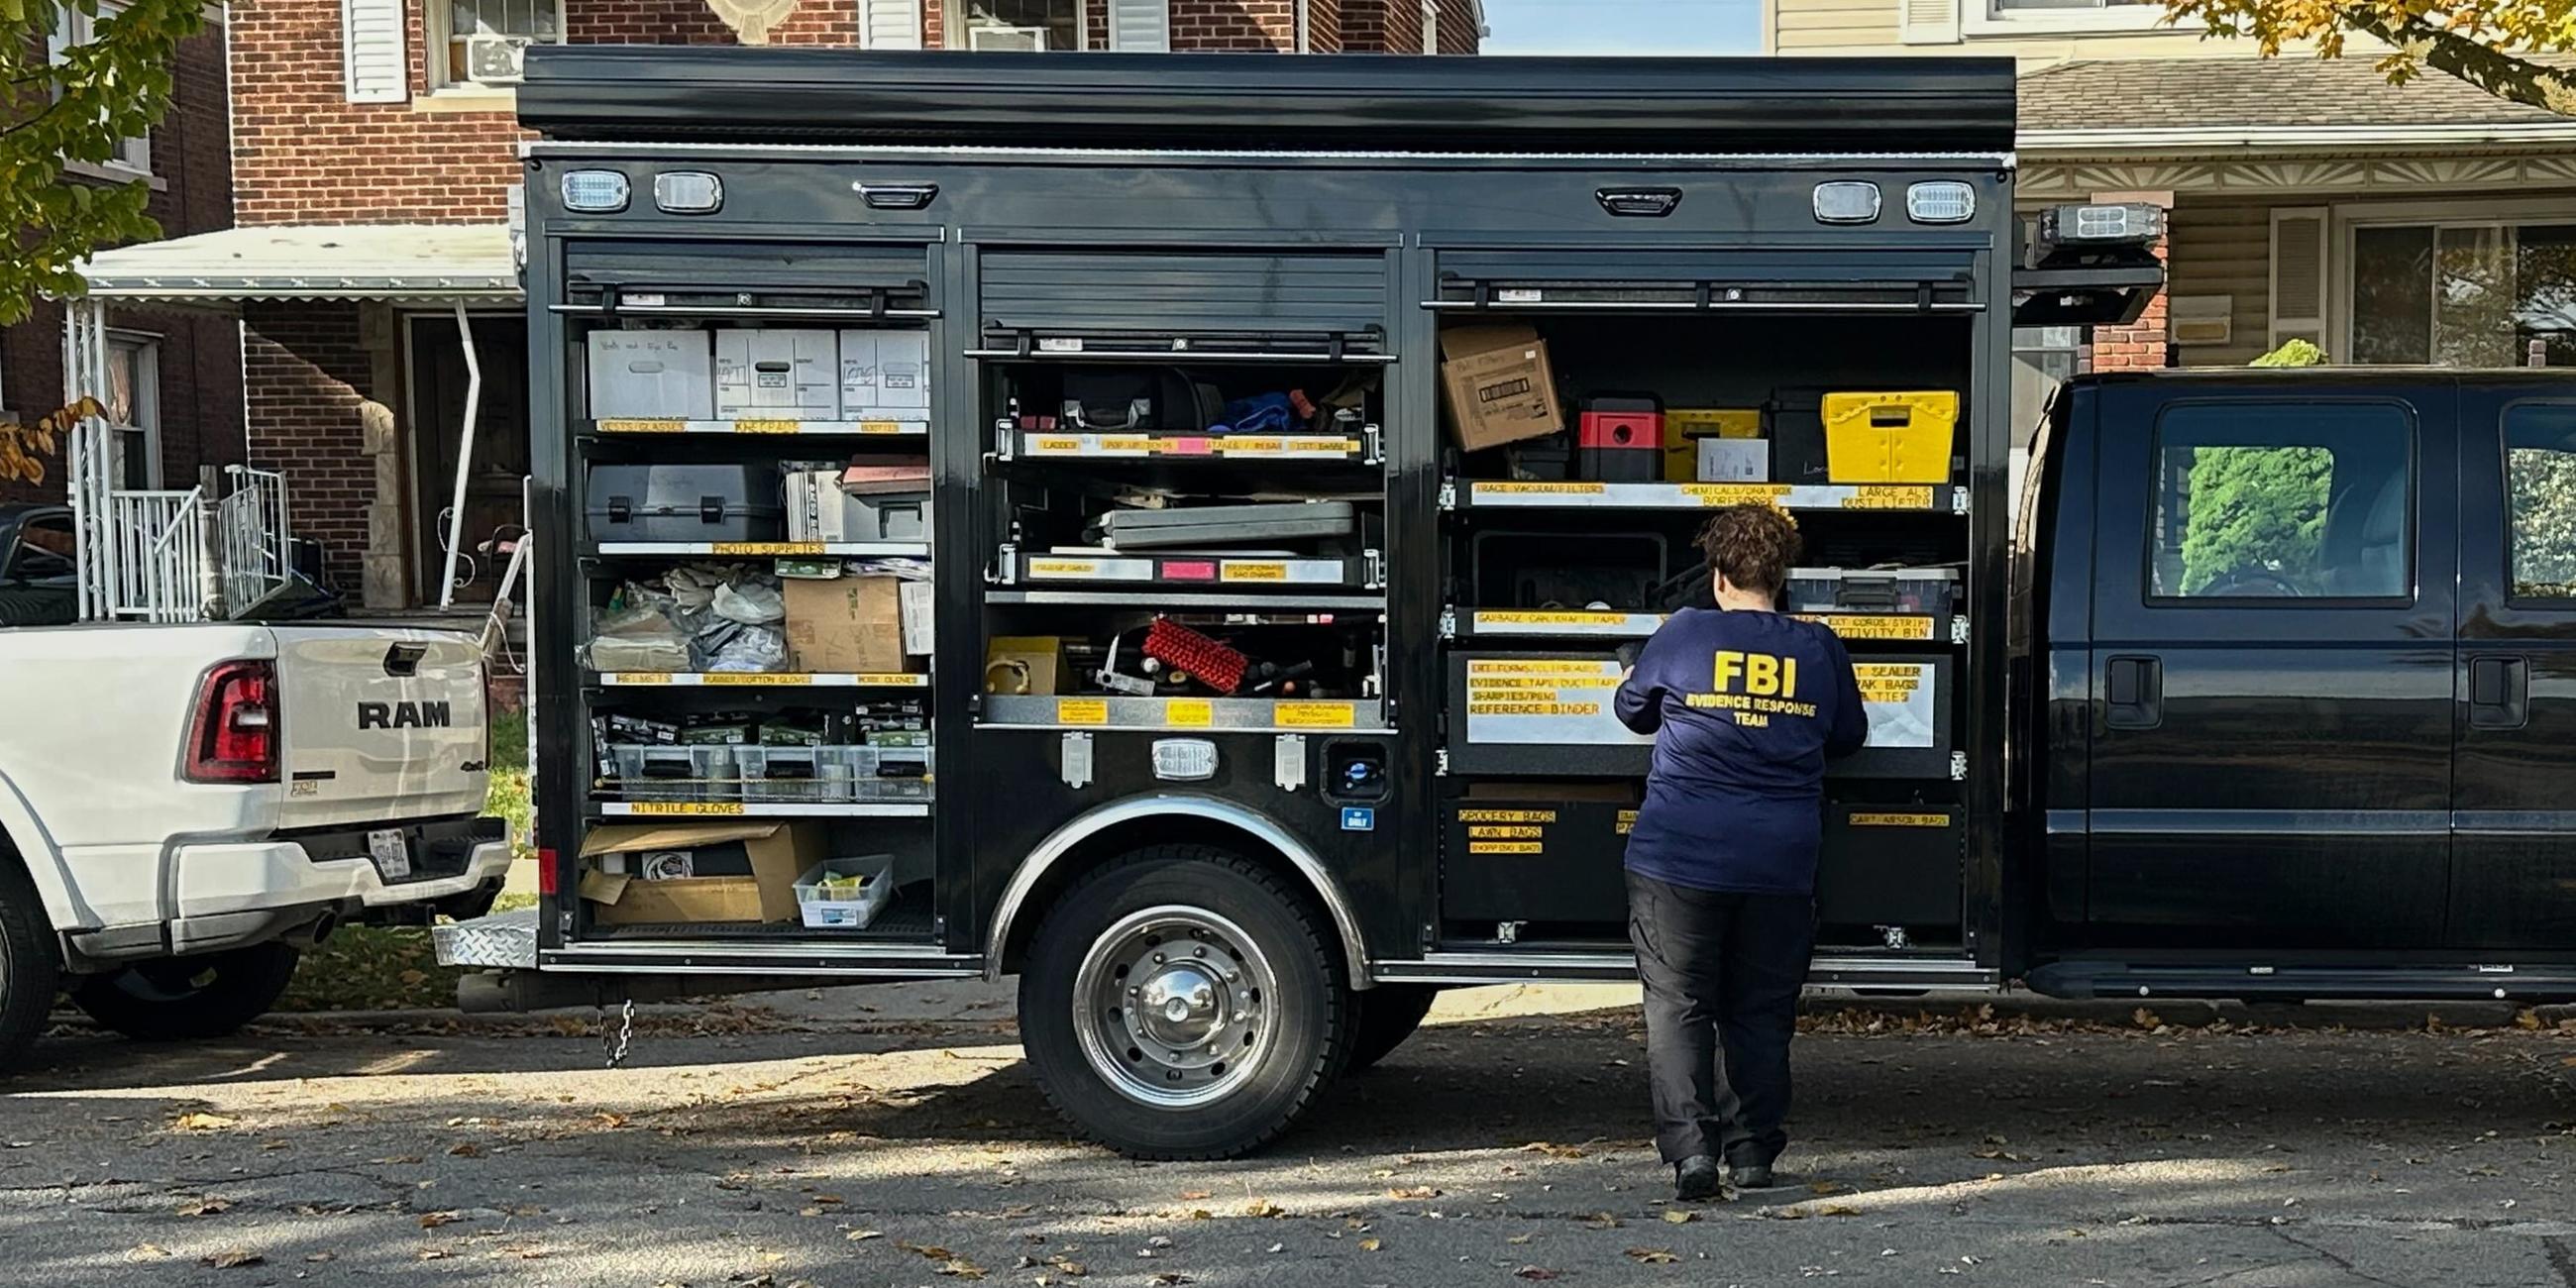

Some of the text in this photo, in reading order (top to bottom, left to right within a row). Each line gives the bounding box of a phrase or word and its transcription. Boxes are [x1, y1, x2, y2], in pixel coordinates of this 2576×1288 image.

[735, 421, 800, 433] KNEEPADS
[1858, 486, 1931, 498] LARGE ALS
[1841, 497, 1931, 509] DUST LIFTER
[712, 543, 825, 555] PHOTO SUPPLIES
[1903, 628, 1928, 639] BIN
[1714, 650, 1796, 698] FBI
[1872, 666, 1921, 677] SEALER
[616, 674, 673, 684] HELMETS
[1470, 678, 1522, 688] EVIDENCE
[1885, 680, 1919, 691] BAGS
[1878, 692, 1909, 702] TIES
[1469, 704, 1600, 714] REFERENCE BINDER
[1685, 693, 1817, 717] EVIDENCE RESPONSE
[358, 700, 451, 730] RAM
[1733, 711, 1769, 727] TEAM
[631, 804, 744, 814] NITRILE GLOVES
[1459, 810, 1555, 821] GROCERY BAGS
[1470, 826, 1541, 837] LAWN BAGS
